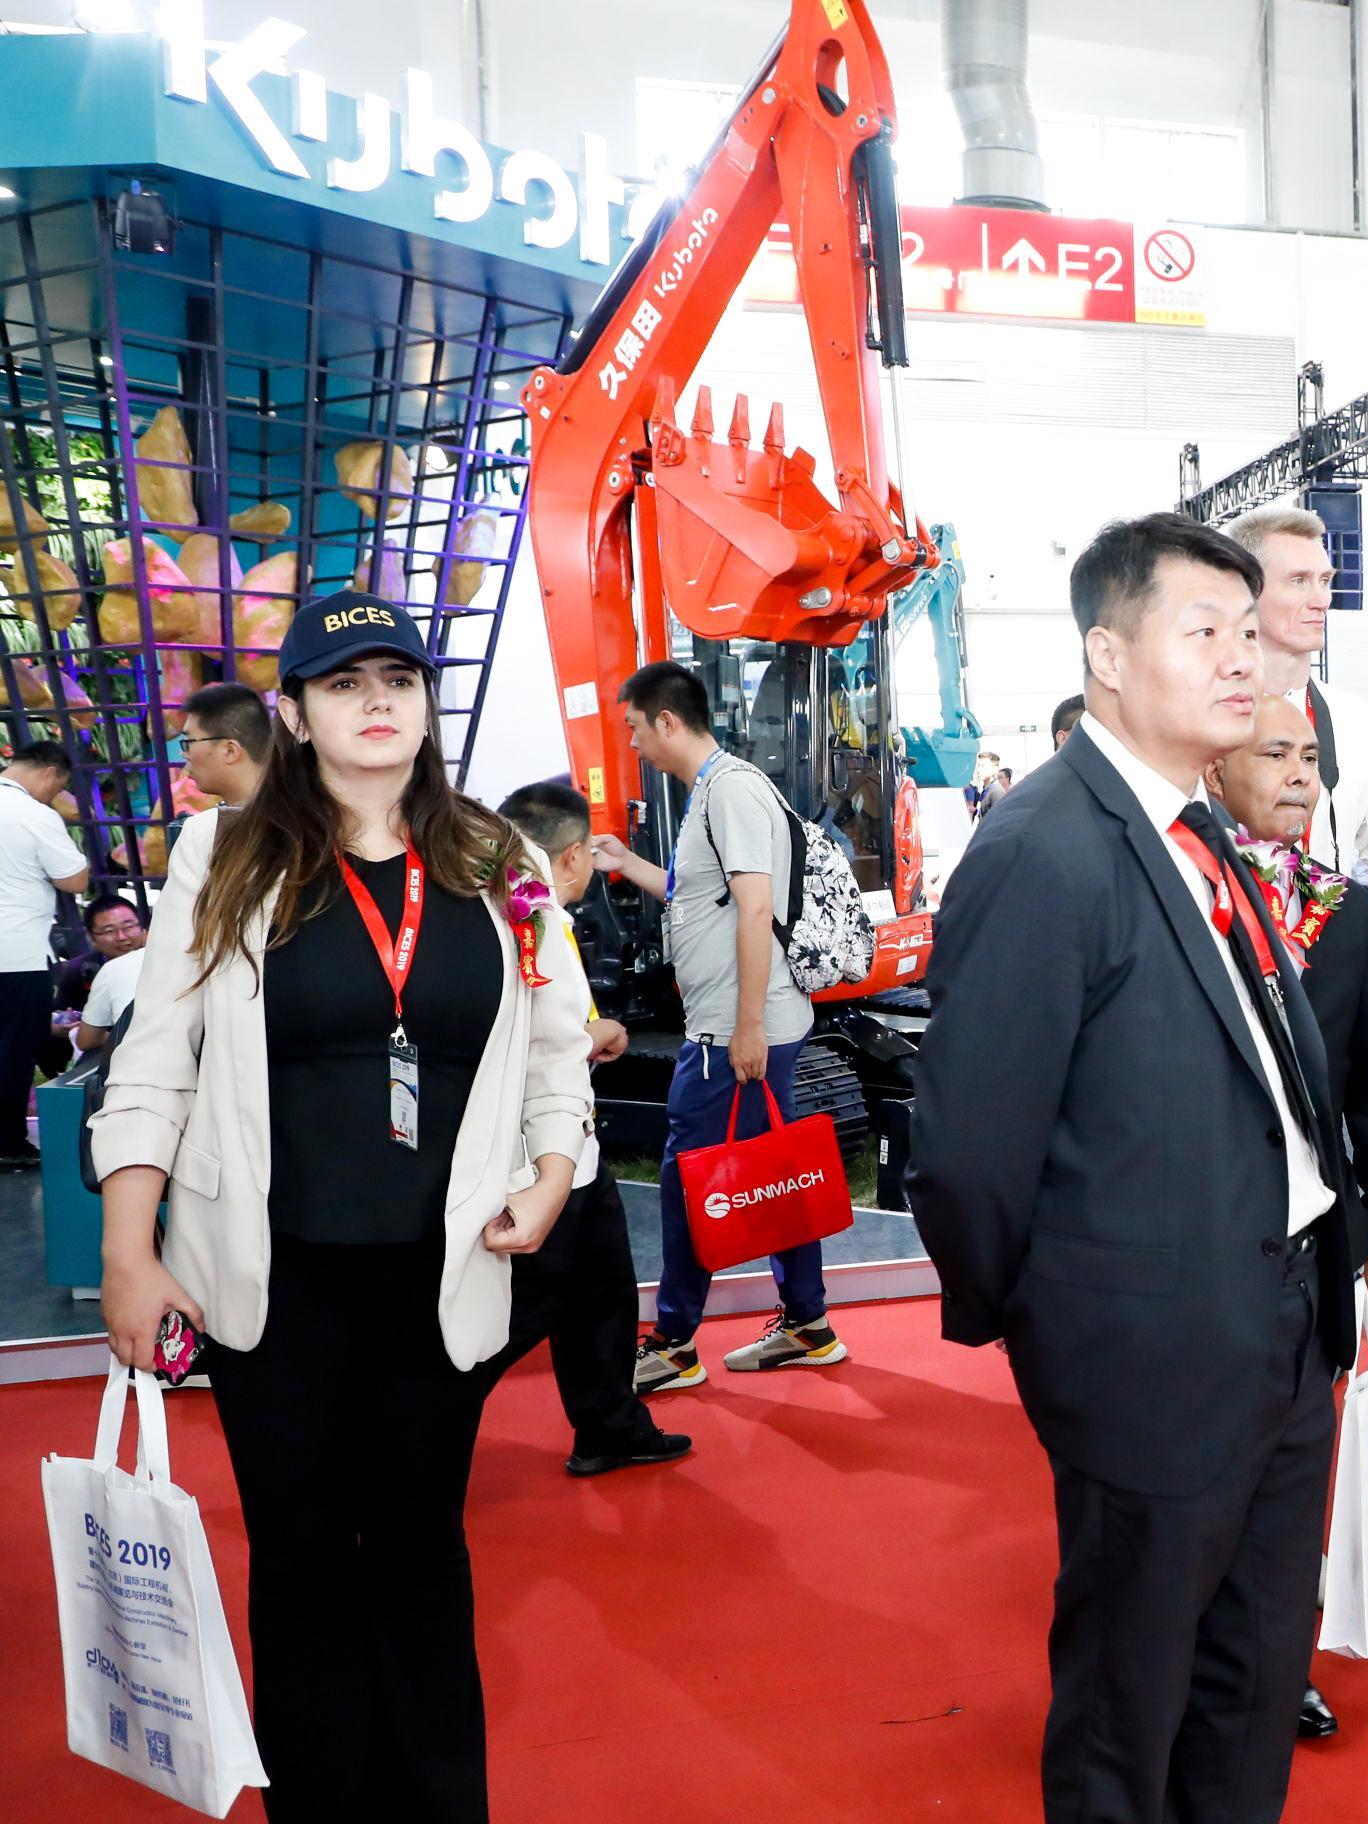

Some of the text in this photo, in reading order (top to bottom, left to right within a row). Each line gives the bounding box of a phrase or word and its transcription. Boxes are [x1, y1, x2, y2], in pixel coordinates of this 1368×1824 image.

[653, 207, 719, 298] Kubota
[1058, 242, 1124, 291] E2
[599, 298, 663, 401] 久保田
[324, 606, 396, 633] BICES
[409, 868, 420, 903] BICES 2019
[396, 927, 415, 971] BICES 2019
[731, 1168, 825, 1209] SUNMACH
[117, 1539, 171, 1571] 2019
